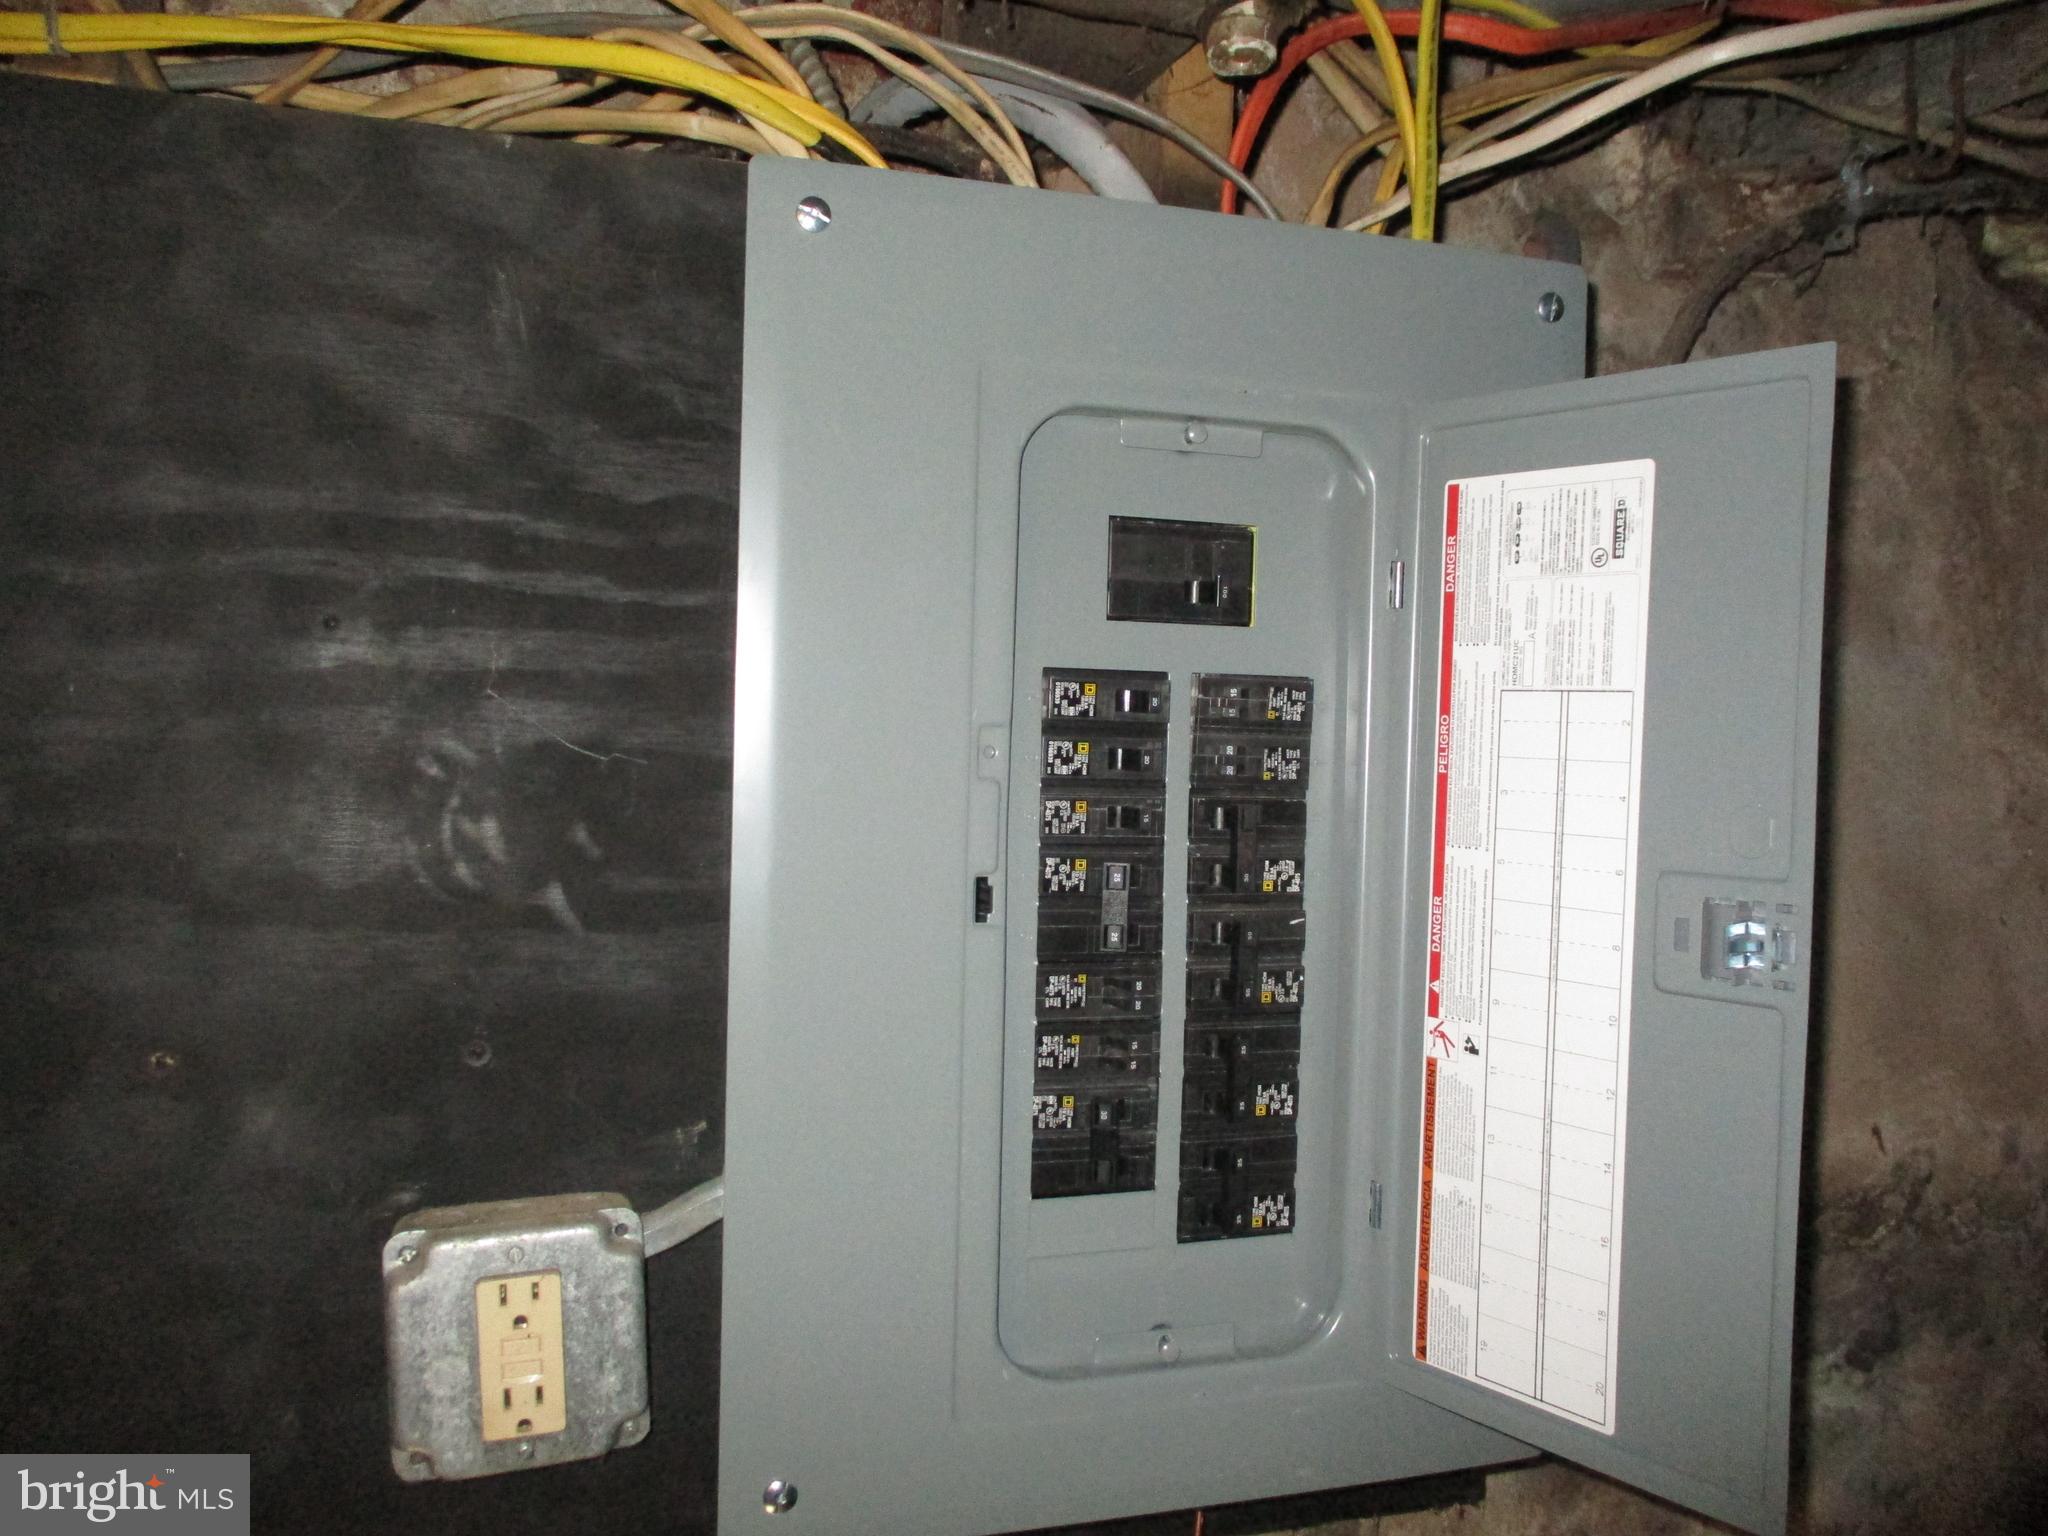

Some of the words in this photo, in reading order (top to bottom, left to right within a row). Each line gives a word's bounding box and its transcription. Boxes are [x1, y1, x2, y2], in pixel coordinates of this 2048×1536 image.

[1615, 509, 1626, 558] SQUARE
[1445, 535, 1457, 593] DANGER
[1230, 688, 1237, 697] 15
[1152, 697, 1158, 707] 20
[1229, 708, 1236, 717] 15
[1438, 714, 1449, 773] PELIGRO
[1226, 745, 1233, 755] 20
[1144, 755, 1150, 765] 20
[1226, 766, 1233, 776] 20
[1143, 814, 1149, 823] 15
[1114, 873, 1120, 882] 25
[1431, 896, 1442, 953] DANGER
[1111, 932, 1118, 942] 25
[1136, 981, 1142, 991] 20
[1135, 1000, 1141, 1010] 20
[1608, 1015, 1616, 1027] 10
[1131, 1041, 1138, 1050] 15
[1130, 1061, 1137, 1070] 15
[1606, 1088, 1614, 1101] 12
[1101, 1110, 1107, 1120] 30
[1425, 1059, 1437, 1169] AVERTISSEMENT
[1487, 1133, 1495, 1145] 13
[1603, 1162, 1611, 1175] 14
[1484, 1203, 1492, 1215] 15
[1420, 1179, 1432, 1272] ADVERTENCIA
[1601, 1235, 1609, 1248] 16
[1481, 1272, 1489, 1284] 17
[1417, 1279, 1428, 1341] WARNING
[1597, 1309, 1605, 1321] 18
[1480, 1340, 1488, 1352] 19
[1595, 1381, 1604, 1395] 20
